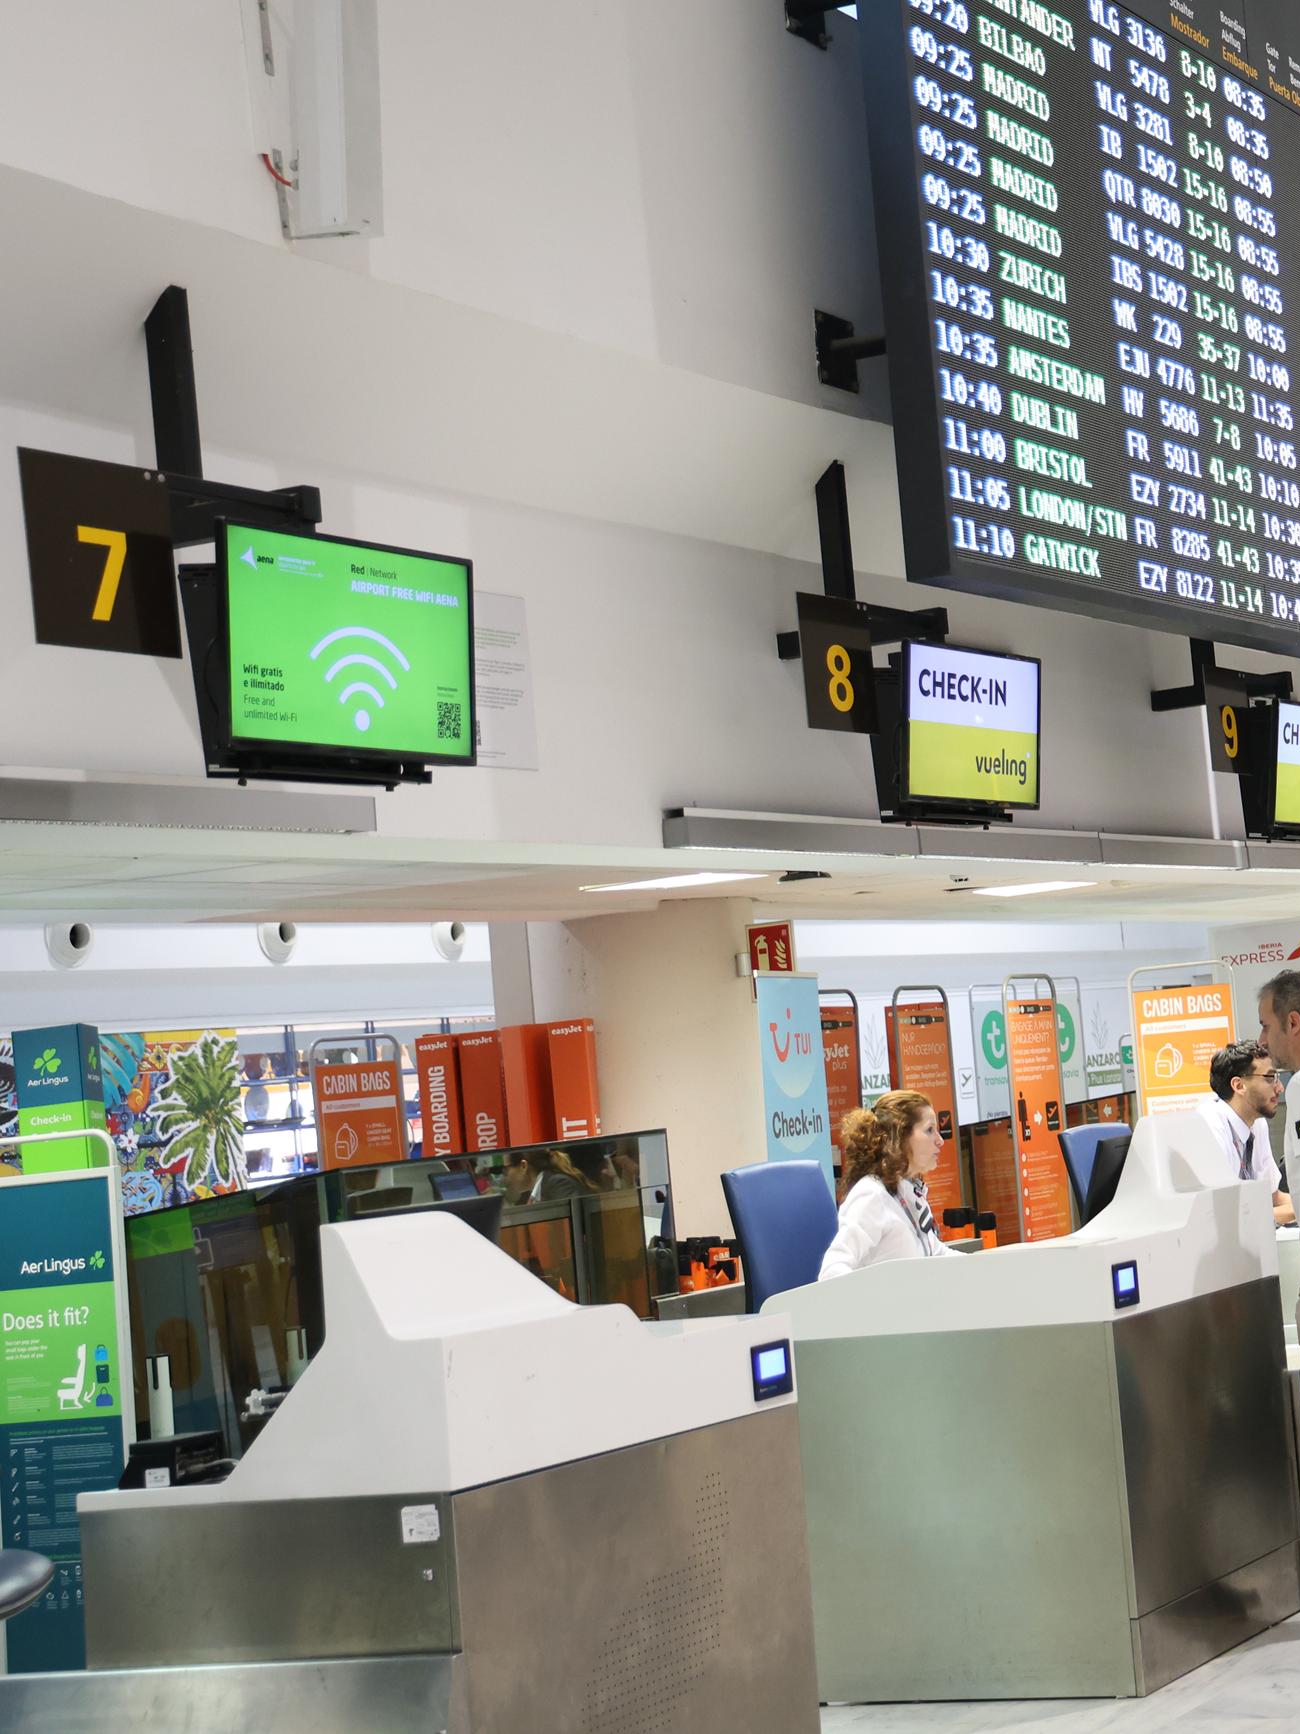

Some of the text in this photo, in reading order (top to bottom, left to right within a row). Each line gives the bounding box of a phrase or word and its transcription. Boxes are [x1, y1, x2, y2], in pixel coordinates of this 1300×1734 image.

[1170, 13, 1210, 48] Mostrador
[1220, 11, 1246, 38] Boarding
[1221, 29, 1242, 53] Abflug
[1266, 42, 1280, 60] Gate
[1089, 0, 1266, 121] VLG 3136 8-10 08:35
[1222, 46, 1260, 81] Embarque
[1091, 37, 1269, 160] NT 5478 3-4 08:35
[1268, 76, 1291, 100] Puerta
[927, 221, 990, 273] 10:30
[998, 251, 1066, 304] ZURICH
[1151, 314, 1182, 350] 229
[1197, 332, 1240, 372] 35-37
[1247, 352, 1290, 392] 10:00
[932, 270, 994, 320] 10:35
[1002, 298, 1070, 349] NANTES
[1118, 342, 1150, 379] EJU
[1156, 357, 1196, 395] 4776
[1200, 373, 1245, 414] 11-13
[1250, 392, 1293, 431] 11:35
[936, 319, 1297, 470] 10:35 AMSTERDAM HV 5686 7-8 10:05
[949, 466, 1011, 511] 11:05
[1019, 486, 1128, 541] LONDON/STN
[1134, 516, 1158, 549] FR
[1170, 526, 1211, 561] 8285
[1216, 539, 1260, 574] 41-43
[256, 554, 274, 565] aena
[351, 563, 397, 580] Red Network
[953, 516, 1015, 558] 11:10
[1024, 533, 1101, 578] GATWICK
[1138, 560, 1168, 593] EZY
[1174, 569, 1215, 603] 8122
[1219, 579, 1263, 614] 11-14
[76, 524, 127, 622] 7
[351, 580, 459, 608] AIRPORT FREE WIFI AENA
[243, 664, 283, 678] Wifi gratis
[826, 644, 855, 712] 8
[244, 679, 284, 692] e ilimitado
[918, 668, 1008, 706] CHECK-IN
[244, 695, 276, 706] Free and
[244, 709, 298, 722] unlimited Wi-Fi
[1221, 704, 1240, 759] 9
[975, 748, 1028, 786] vueling
[1221, 950, 1284, 967] EXPRESS
[1258, 942, 1283, 950] IBERIA
[1142, 993, 1222, 1018] CABIN BAGS
[462, 1036, 492, 1046] easyJet
[551, 1026, 582, 1036] easyJet
[418, 1040, 448, 1052] easyJet
[794, 1033, 812, 1056] TUI
[832, 1058, 848, 1072] plus
[28, 1076, 69, 1088] Aer Lingus
[322, 1071, 390, 1096] CABIN BAGS
[428, 1065, 450, 1146] BOARDING
[30, 1113, 72, 1126] Check-in
[772, 1108, 823, 1139] Check-in
[20, 1258, 86, 1275] Aer Lingus
[3, 1306, 90, 1331] Does it fit?
